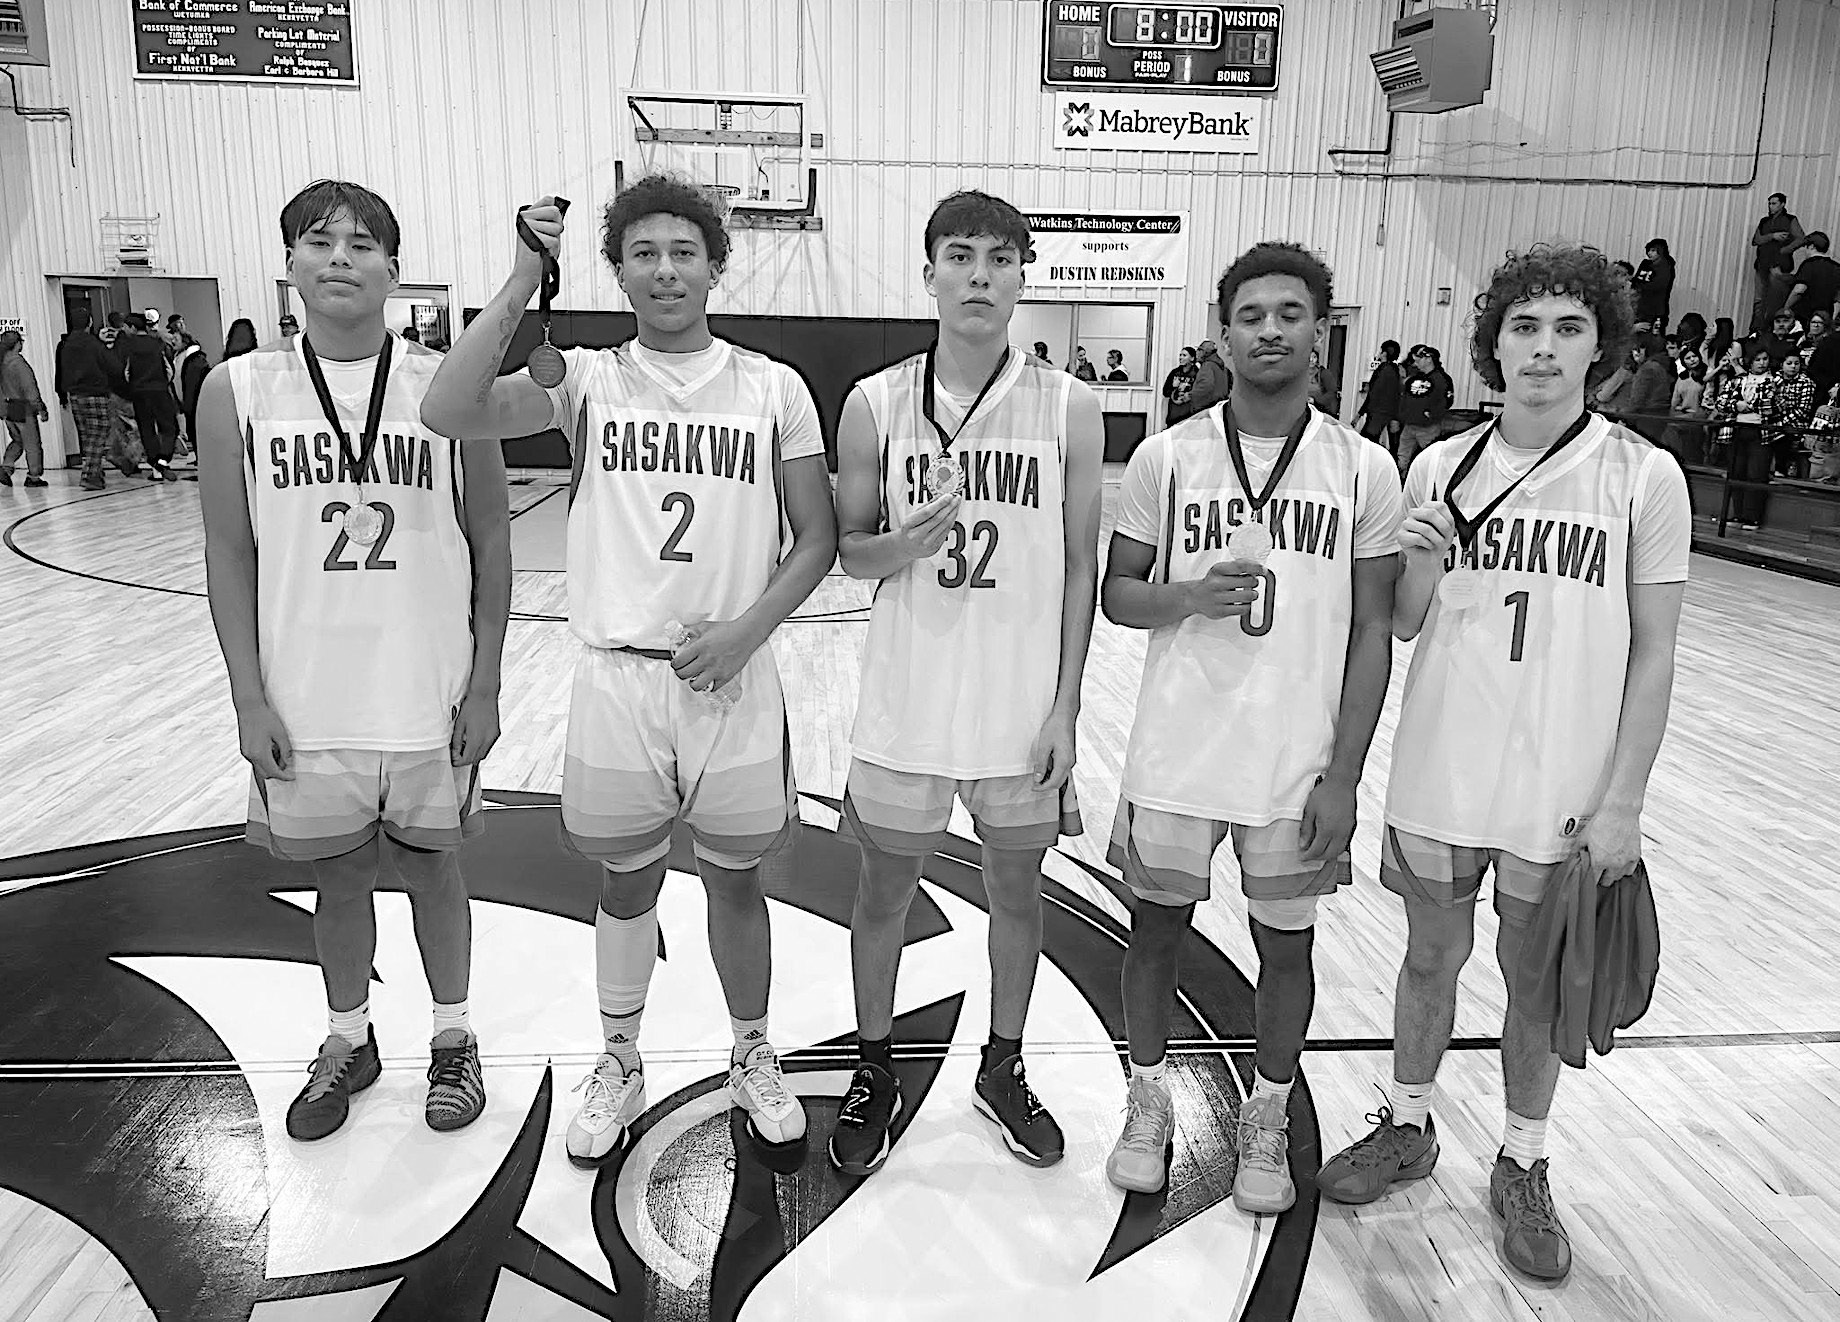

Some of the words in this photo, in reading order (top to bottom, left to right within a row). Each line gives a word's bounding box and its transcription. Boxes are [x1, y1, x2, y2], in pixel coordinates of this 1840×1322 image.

[140, 0, 166, 10] Bank
[184, 0, 238, 12] Commerce
[249, 1, 286, 13] American
[288, 2, 324, 16] Exchange
[327, 3, 346, 15] Bank
[1059, 5, 1100, 21] HOME
[1136, 9, 1213, 42] 8:00
[1224, 11, 1278, 27] VISITOR
[258, 27, 287, 41] Parking
[289, 28, 303, 40] Lot
[307, 29, 340, 41] Material
[149, 52, 177, 64] First
[209, 53, 236, 66] Bank
[273, 55, 295, 66] Ralph
[1143, 51, 1162, 59] POSS
[292, 66, 324, 76] Barbara
[1073, 66, 1107, 78] BONUS
[1134, 61, 1170, 72] PERIOD
[1217, 70, 1250, 82] BONUS
[1029, 217, 1073, 229] Watkins
[1075, 217, 1134, 232] Technology
[1136, 219, 1173, 230] Center
[1082, 241, 1129, 253] supports
[1050, 266, 1097, 281] DUSTIN
[1101, 266, 1165, 281] REDSKINS
[602, 421, 755, 484] SASAKWA
[270, 432, 433, 490] SASAKWA
[905, 450, 1039, 509] SAAKWA
[660, 491, 695, 562] 2
[1184, 498, 1340, 560] SASKWA
[321, 501, 396, 571] 22
[938, 520, 999, 588] 32
[1504, 590, 1529, 662] 1
